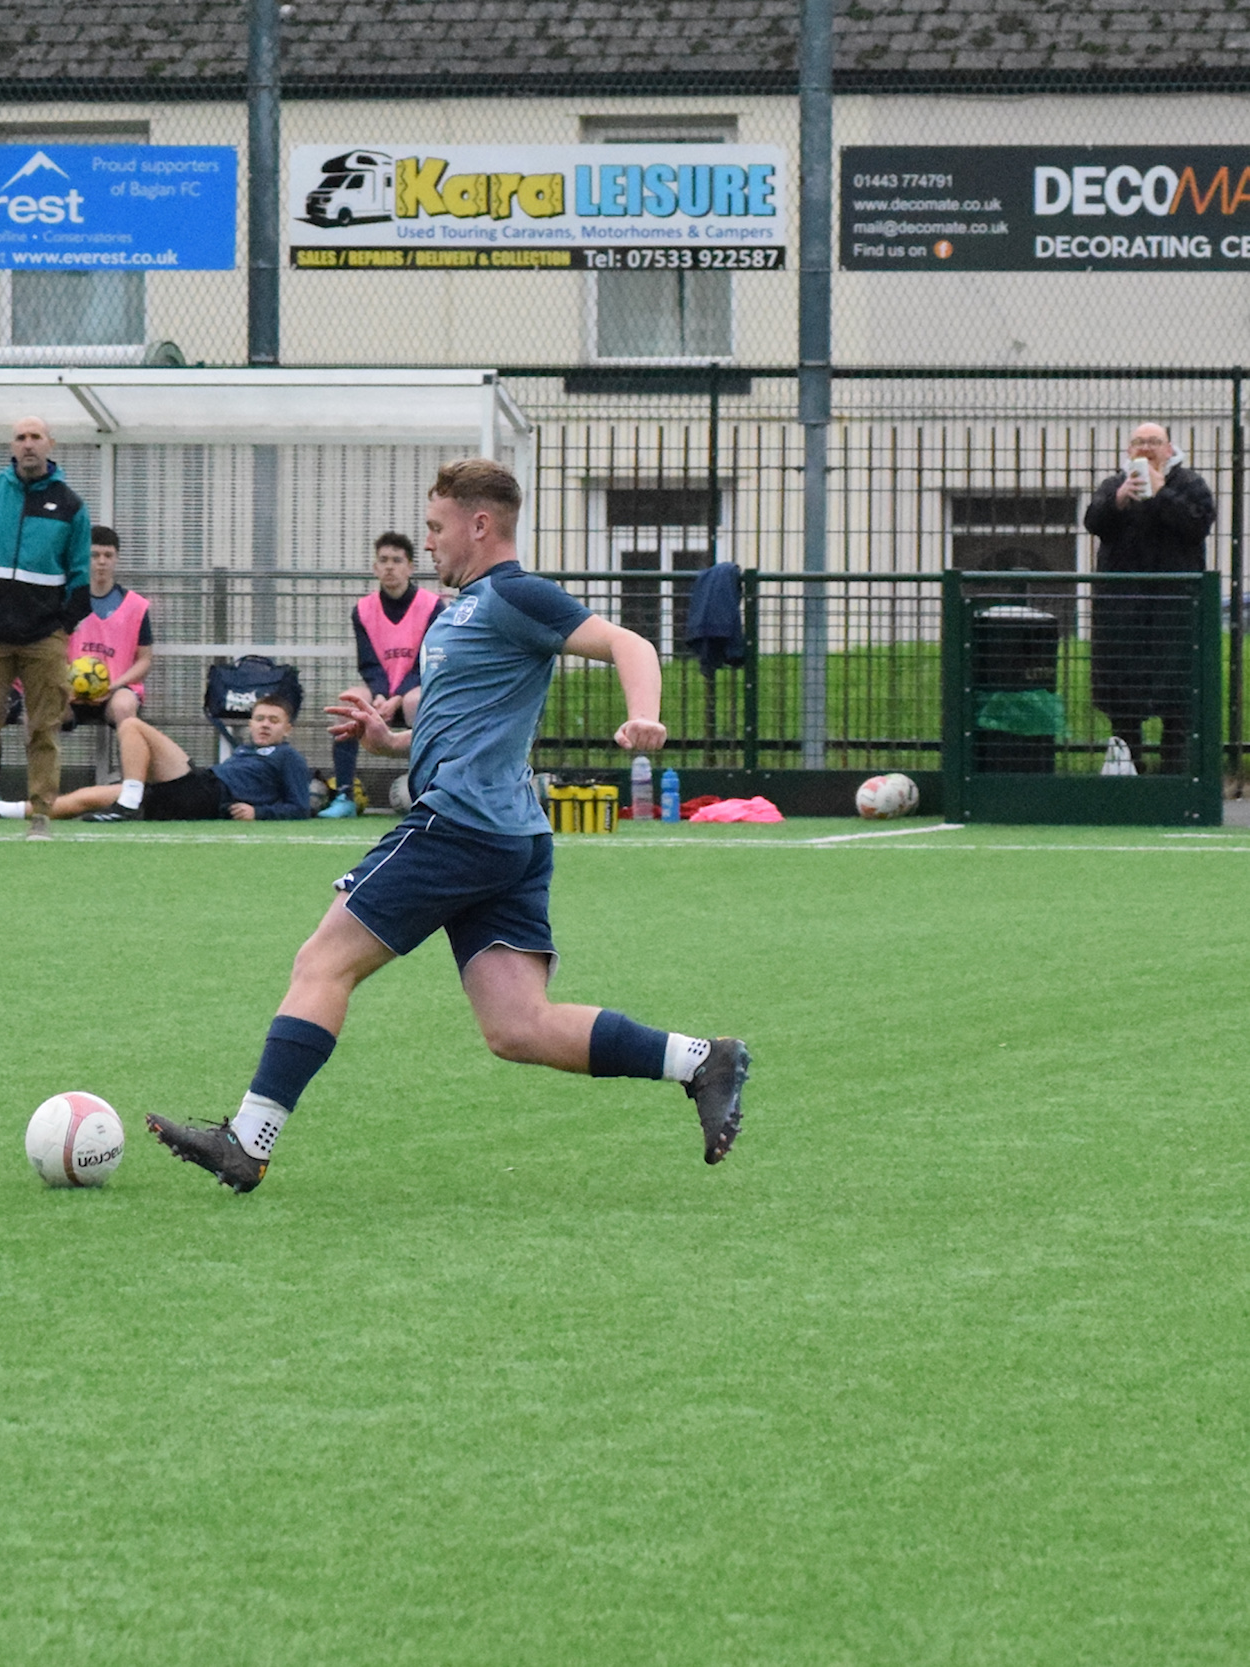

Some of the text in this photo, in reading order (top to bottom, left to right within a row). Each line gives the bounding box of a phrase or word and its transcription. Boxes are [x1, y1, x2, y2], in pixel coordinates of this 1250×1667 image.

[92, 156, 220, 175] Proud supporters
[395, 156, 565, 220] Kara
[853, 174, 953, 188] 01443 774791
[110, 180, 201, 200] of Baglan FC
[575, 164, 777, 219] LEISURE
[853, 198, 1002, 211] www.decomate.co.uk
[43, 230, 133, 243] Conservatories
[397, 225, 775, 242] Used Touring Caravans, Motorhomes & Campers
[853, 220, 1009, 237] mail@decomate.co.uk
[853, 243, 885, 257] Find
[887, 246, 905, 257] us
[908, 247, 927, 257] on
[1035, 235, 1212, 258] DECORATING
[12, 249, 179, 265] www.everest.co.uk
[297, 250, 337, 266] SALES
[348, 250, 404, 266] REPAIRS
[416, 250, 478, 266] DELIVERY
[491, 250, 571, 267] COLLECTION
[583, 250, 778, 267] Tel: 07533 922587
